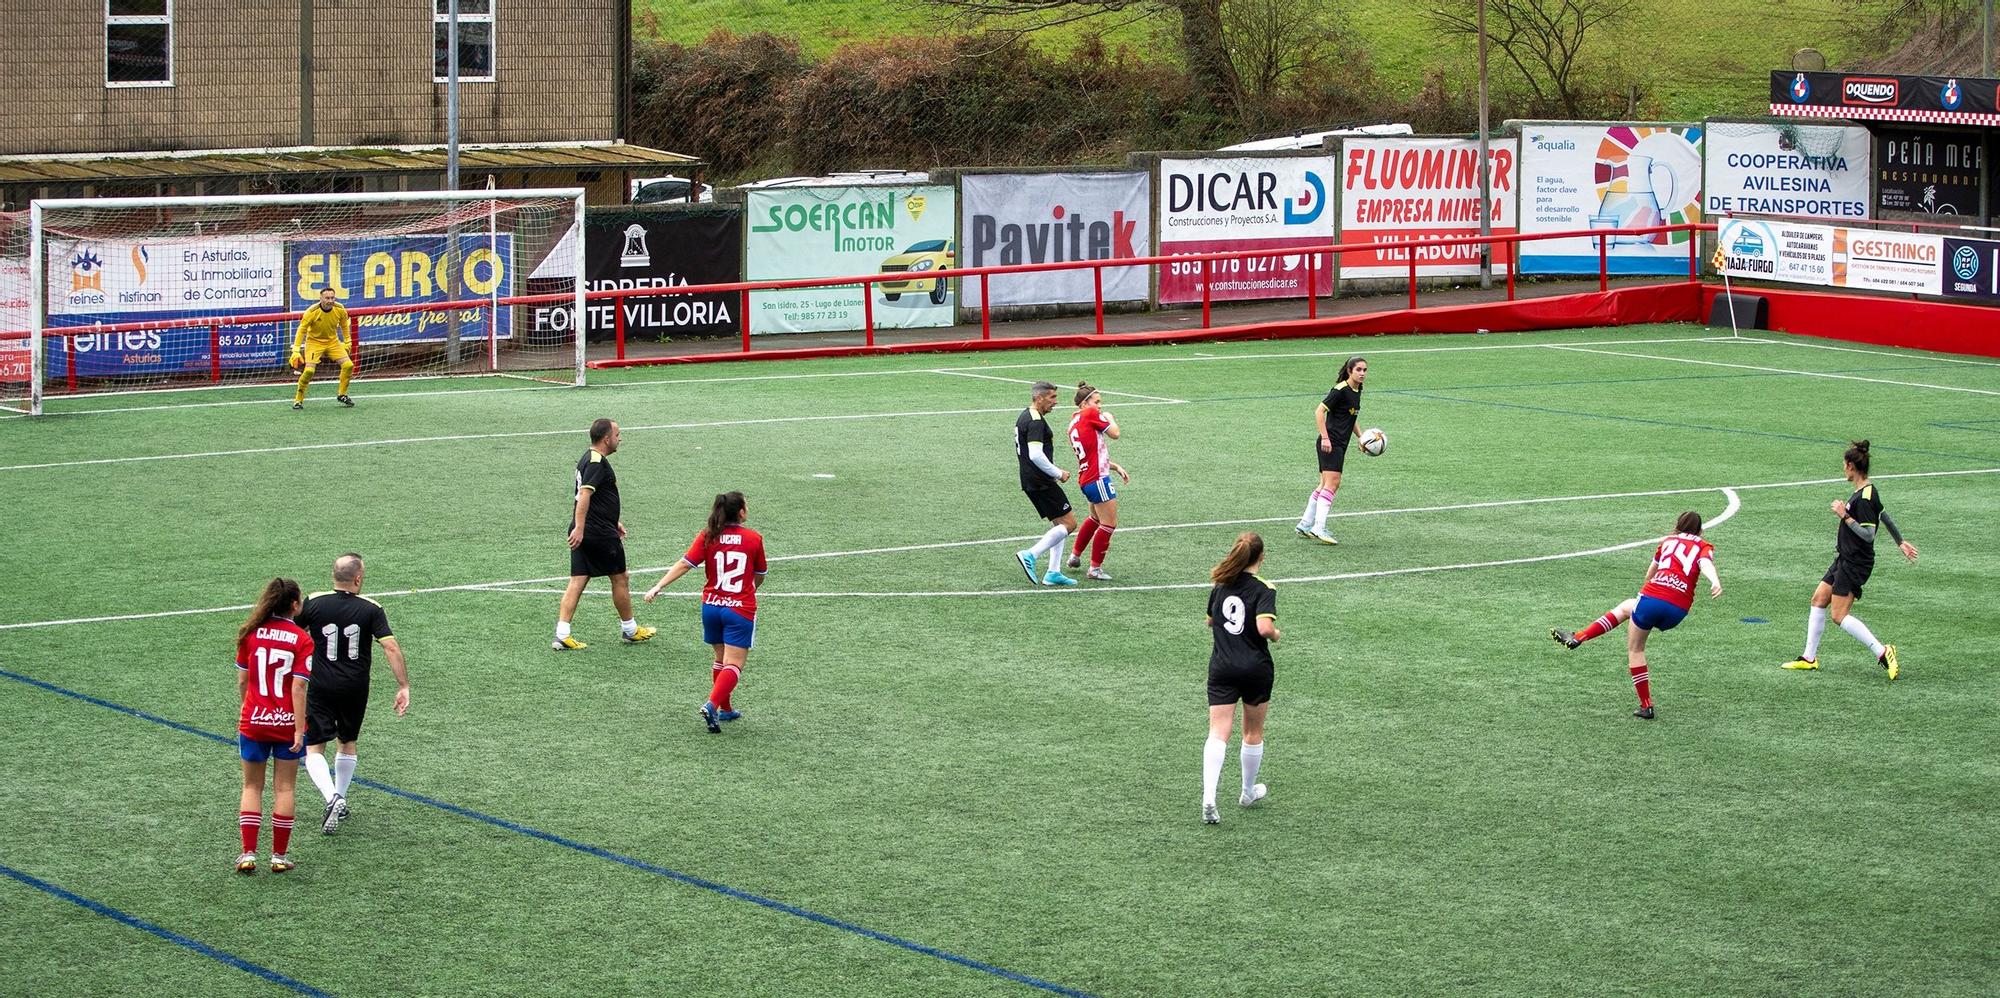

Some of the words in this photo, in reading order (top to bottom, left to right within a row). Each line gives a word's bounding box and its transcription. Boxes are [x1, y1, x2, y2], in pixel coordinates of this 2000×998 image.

[1846, 82, 1894, 99] OQUENDO
[1537, 139, 1575, 152] aqualia
[1889, 136, 1934, 166] PEÑA
[1727, 153, 1848, 172] COOPERATIVA
[1536, 176, 1543, 184] El
[1545, 177, 1565, 186] agua,
[1743, 176, 1831, 193] AVILESINA
[1169, 171, 1277, 213] DICAR
[1536, 185, 1557, 194] factor
[1559, 186, 1578, 194] clave
[1536, 196, 1553, 205] para
[1710, 196, 1732, 211] DE
[1738, 197, 1864, 216] TRANSPORTES
[1357, 198, 1432, 224] EMPRESA
[1437, 197, 1502, 223] MINEA
[1536, 206, 1543, 214] el
[1545, 205, 1580, 214] desarrollo
[752, 191, 895, 252] SOERCAN
[1168, 214, 1223, 227] Construcciones
[1225, 217, 1230, 228] y
[1231, 213, 1263, 227] Proyectos
[1265, 212, 1278, 223] S.A.
[1536, 214, 1573, 223] sostenible
[842, 236, 895, 252] MOTOR
[972, 205, 1136, 269] Pavitek
[184, 250, 197, 262] En
[202, 248, 250, 262] Asturias,
[1852, 239, 1936, 262] GESTRINCA
[184, 268, 198, 282] Su
[202, 266, 273, 281] Inmobiliaria
[1748, 259, 1774, 273] FURGO
[1800, 264, 1807, 272] 47
[297, 252, 349, 300] EL
[70, 294, 105, 305] reines
[119, 290, 162, 303] hisfinan
[184, 288, 200, 301] de
[801, 301, 810, 309] 25
[815, 300, 832, 310] Lugo
[833, 299, 842, 308] de
[843, 298, 865, 308] Llaner
[622, 300, 732, 327] VILLORIA
[801, 311, 815, 321] 985
[817, 311, 826, 320] 77
[828, 311, 837, 319] 23
[839, 310, 848, 319] 19
[418, 311, 482, 334] freos
[219, 334, 232, 346] 85
[234, 334, 252, 346] 267
[256, 333, 274, 344] 162
[123, 352, 162, 365] Asturias
[0, 363, 25, 379] 6.70
[719, 534, 742, 545] VERA
[1657, 539, 1701, 577] 24
[714, 550, 748, 594] 12
[1222, 595, 1246, 636] 9
[256, 627, 298, 645] CLAUDIA
[321, 623, 361, 661] 11
[254, 646, 295, 698] 17
